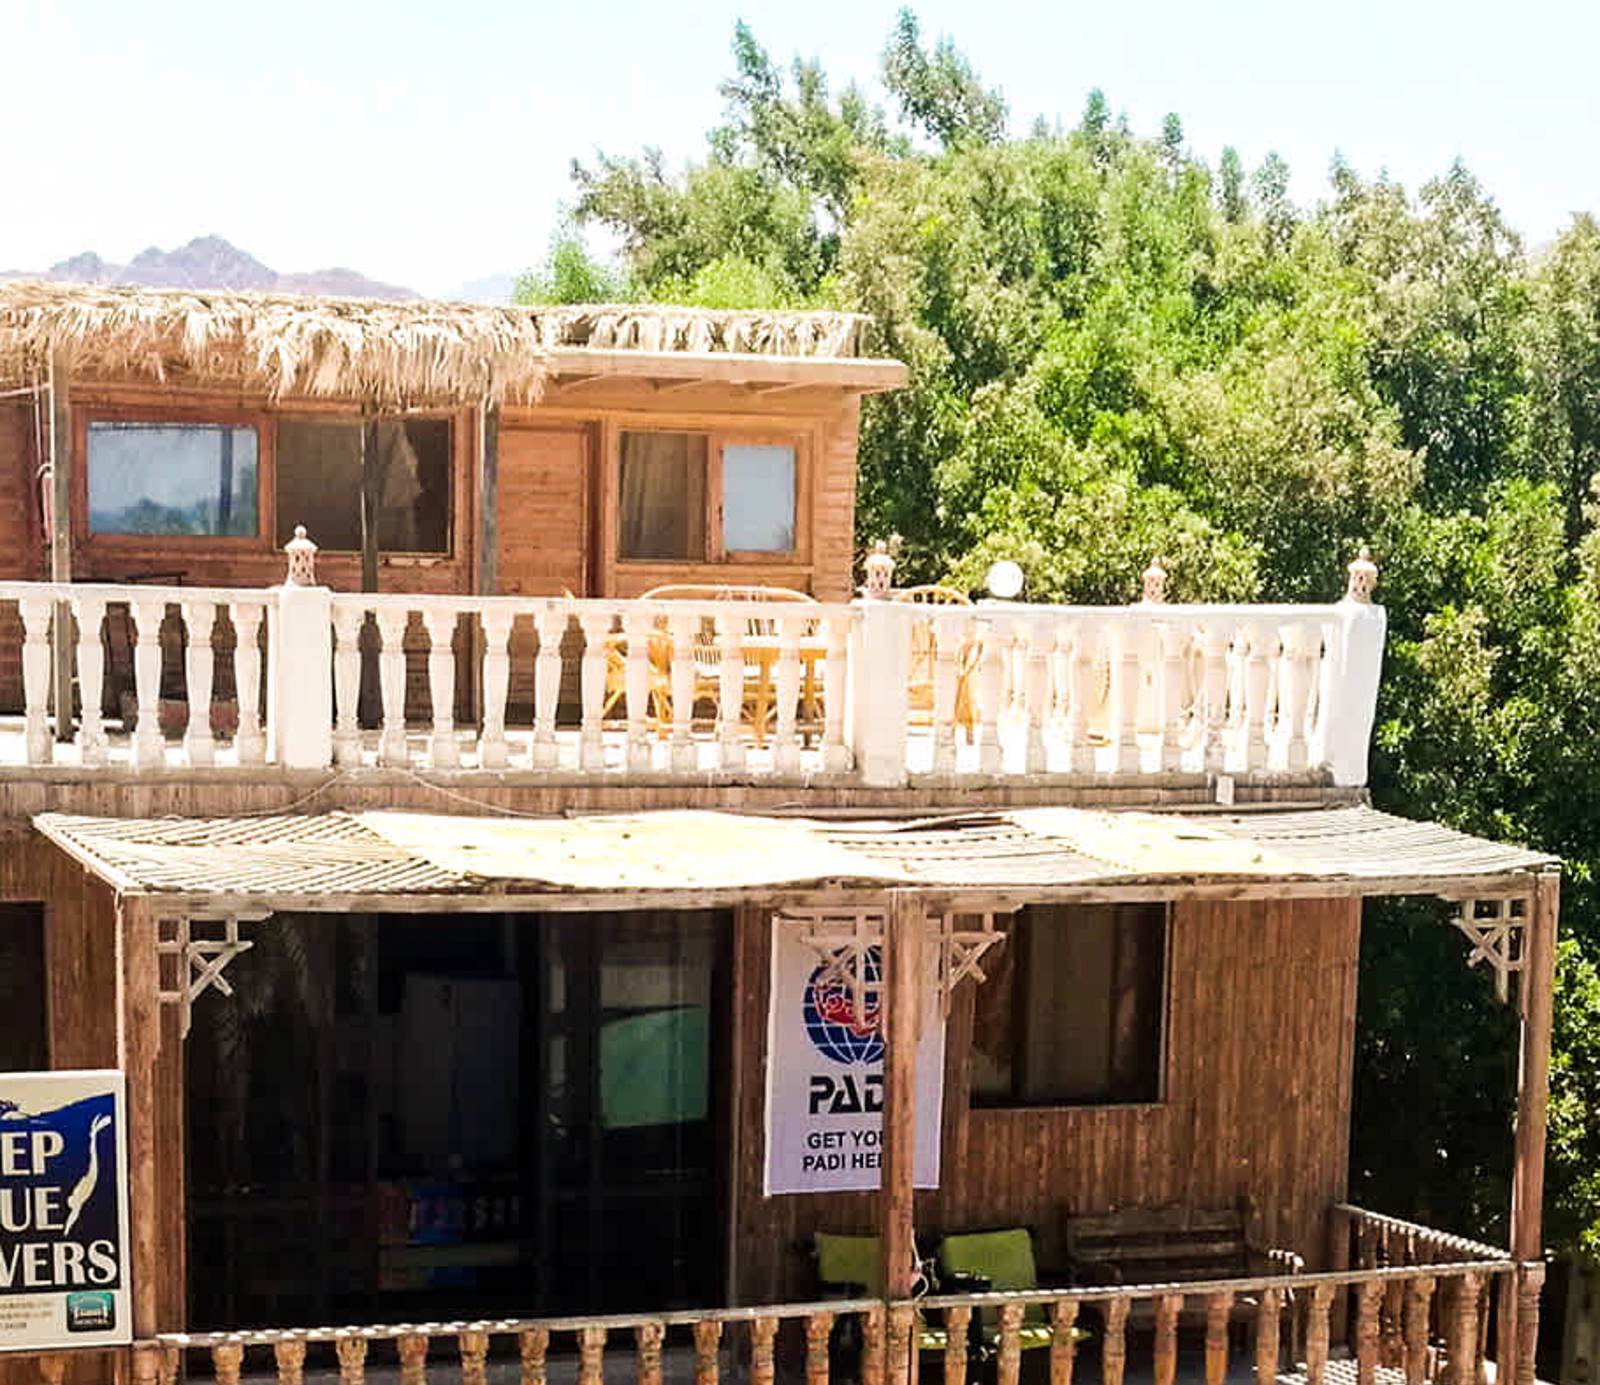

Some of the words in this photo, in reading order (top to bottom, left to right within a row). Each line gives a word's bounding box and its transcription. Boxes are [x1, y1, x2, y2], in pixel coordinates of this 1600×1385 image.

[809, 1075, 884, 1114] PAD
[807, 1131, 846, 1149] GET
[850, 1130, 884, 1147] YO
[803, 1153, 845, 1171] PADI
[852, 1152, 882, 1168] HE
